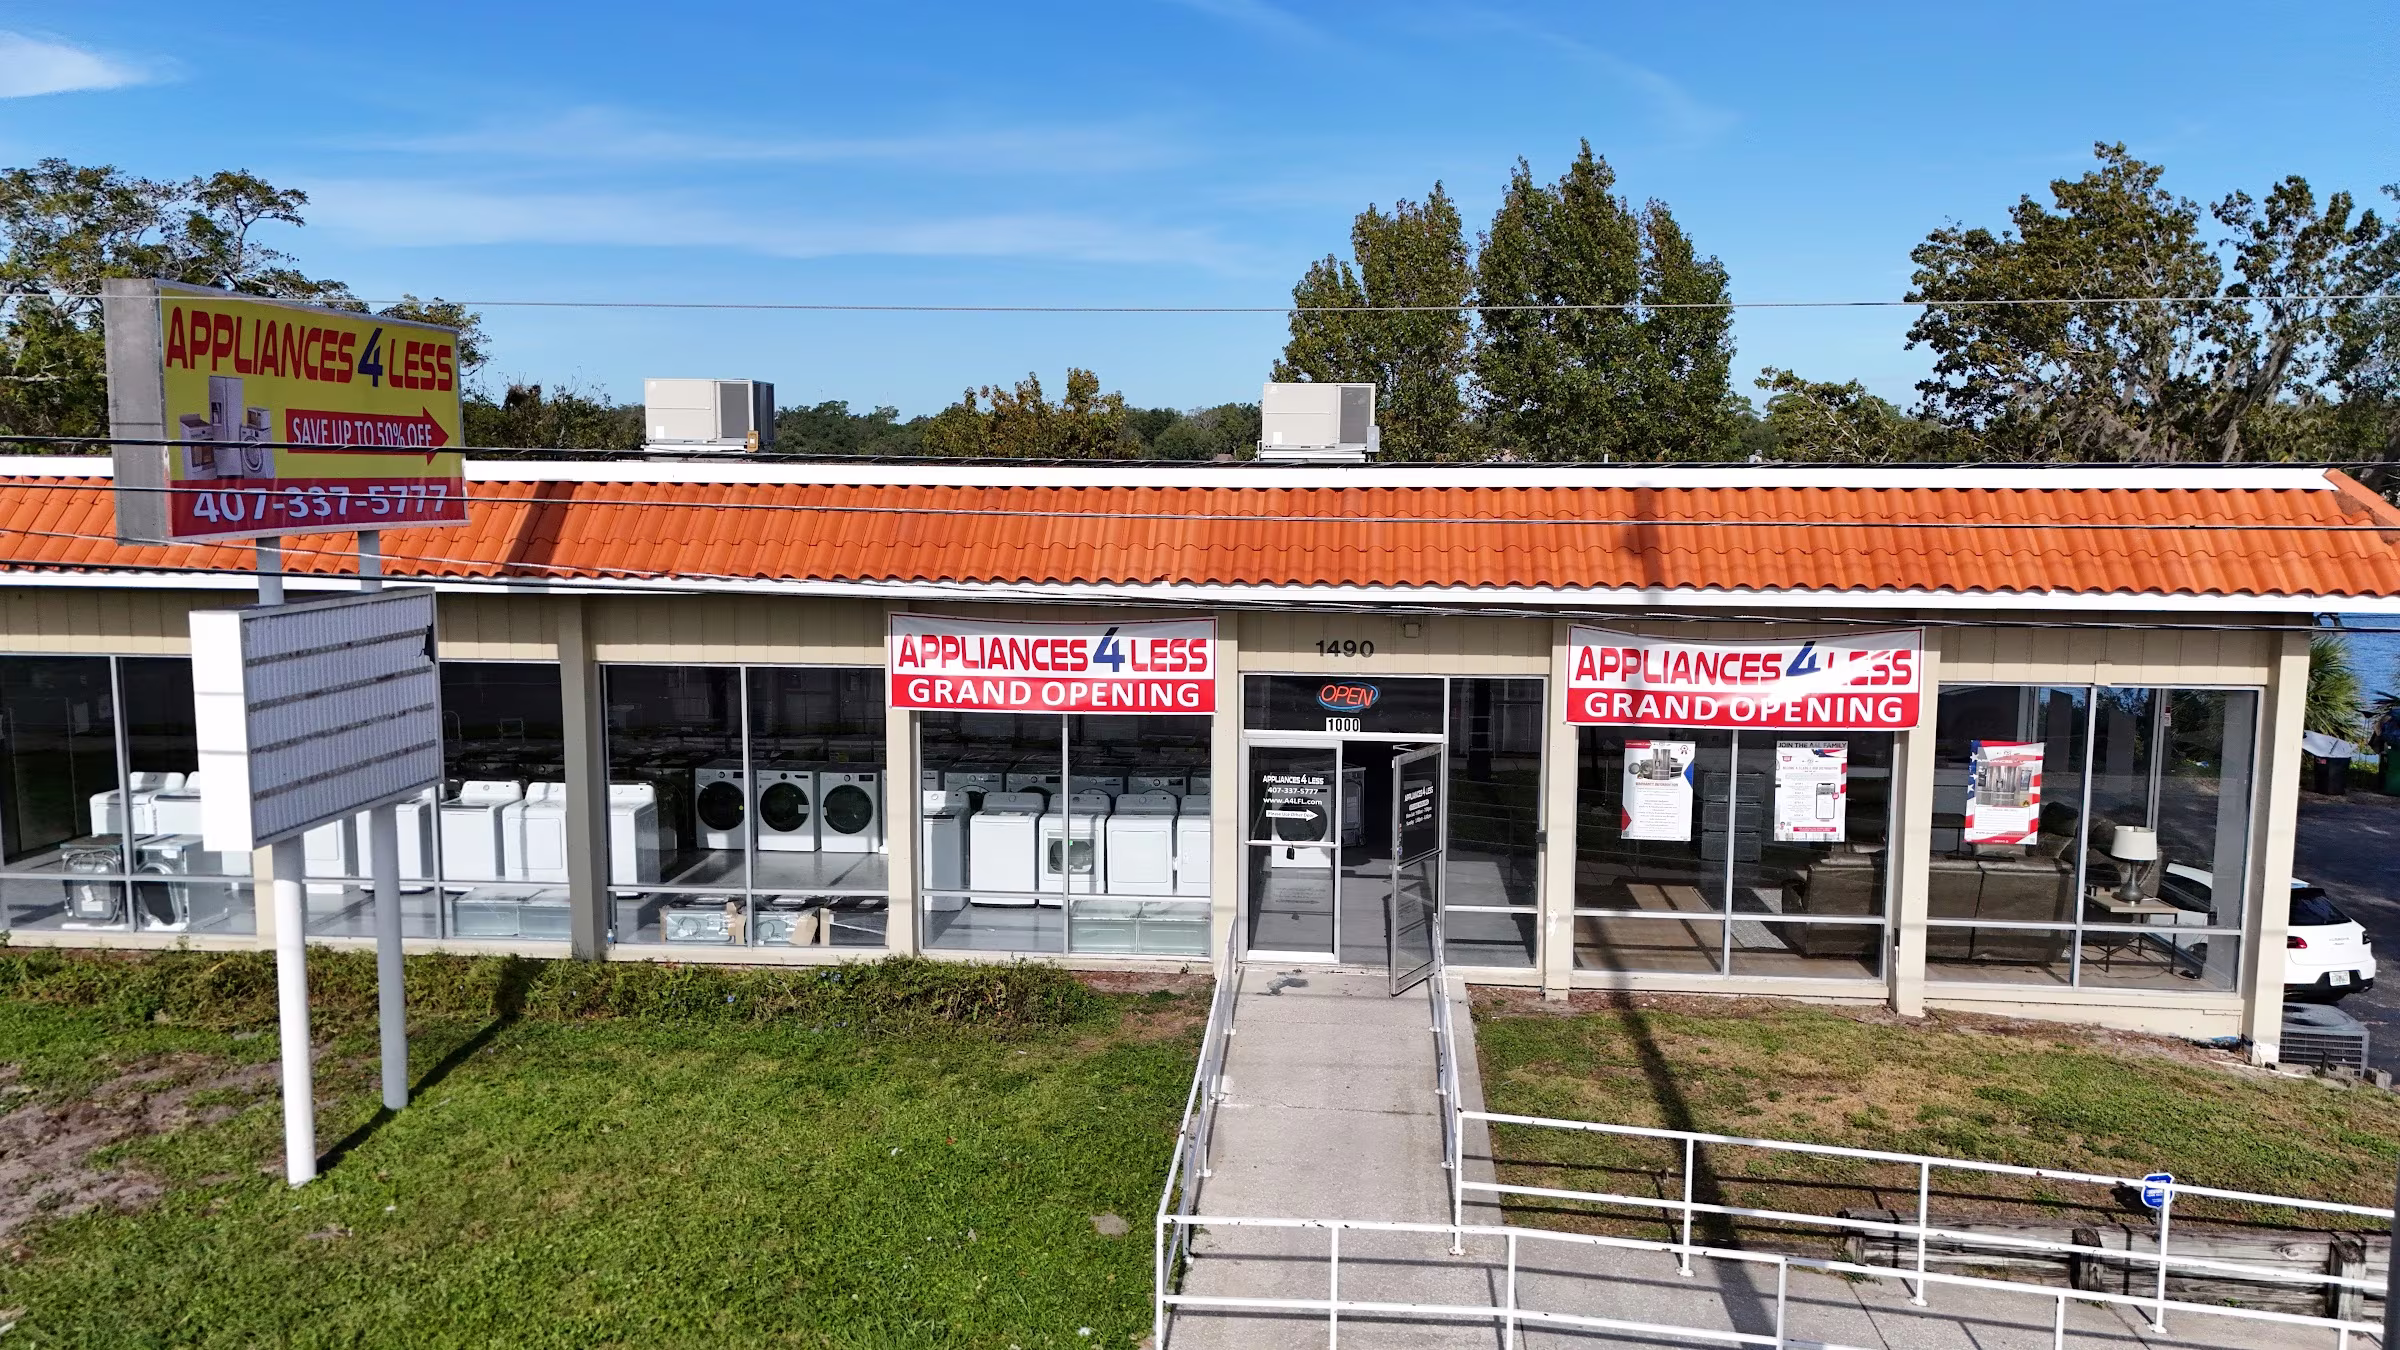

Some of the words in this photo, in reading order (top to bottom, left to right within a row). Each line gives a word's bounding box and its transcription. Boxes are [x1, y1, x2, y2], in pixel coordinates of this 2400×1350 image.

[166, 306, 357, 384] APPLIANCES
[357, 327, 384, 388] 4
[388, 338, 453, 392] LESS
[292, 416, 329, 444] SAVE
[331, 418, 352, 445] UP
[354, 420, 375, 446] TO
[376, 421, 406, 447] 50%
[407, 422, 433, 447] OFF
[192, 484, 448, 523] 407-337-5777
[898, 633, 1089, 673] APPLIANCES
[1092, 626, 1126, 673] 4
[1130, 637, 1208, 673] LESS
[1315, 640, 1374, 658] 1490
[1574, 645, 1783, 687] APPLIANCES
[1785, 640, 1822, 678] 4
[907, 678, 1033, 706] GRAND
[1041, 680, 1200, 708] OPENING
[1321, 684, 1374, 707] OPEN
[1583, 692, 1720, 720] GRAND
[1729, 695, 1903, 723] OPENING
[1328, 718, 1359, 732] 1000
[1262, 775, 1301, 784] APPLIANCES
[1300, 773, 1308, 785] 4
[1307, 776, 1325, 785] LESS
[1267, 786, 1319, 795] 407-337-5777
[1262, 797, 1323, 806] www.A4LFL.com
